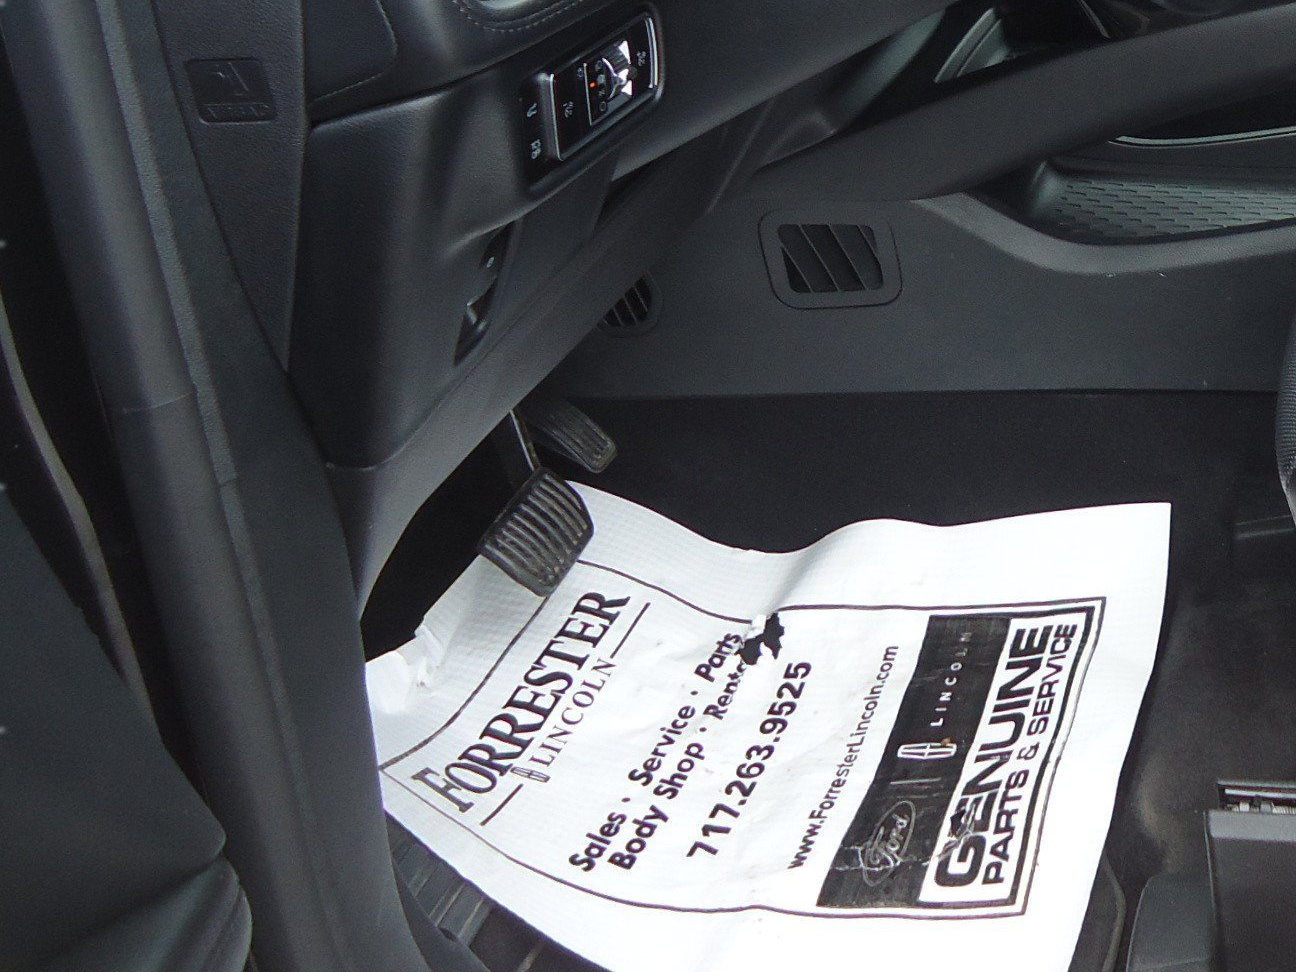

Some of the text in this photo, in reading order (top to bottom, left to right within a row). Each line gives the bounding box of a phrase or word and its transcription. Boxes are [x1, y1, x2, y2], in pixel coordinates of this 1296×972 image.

[410, 591, 631, 813] FORRESTER
[528, 657, 617, 768] LINCOLN
[568, 633, 742, 872] Sales Service Parts
[686, 661, 812, 858] 717.263.9525
[787, 645, 899, 870] www.ForresterLincoln.com
[930, 631, 973, 727] LINCOLN
[934, 625, 1054, 887] GENUINE
[981, 623, 1079, 885] PARTS & SERVICE
[607, 804, 669, 870] Body
[652, 741, 706, 800] Shop
